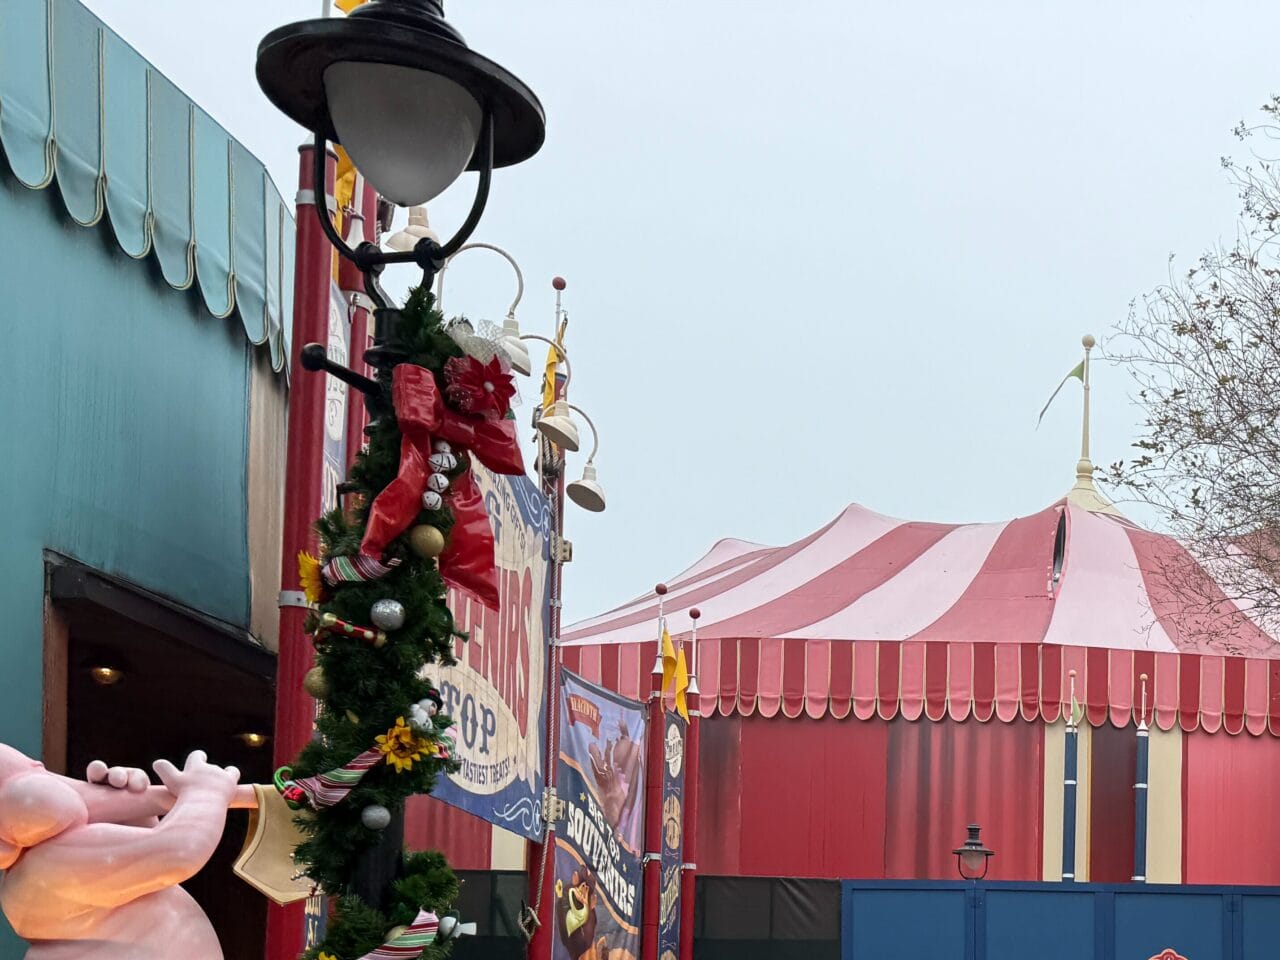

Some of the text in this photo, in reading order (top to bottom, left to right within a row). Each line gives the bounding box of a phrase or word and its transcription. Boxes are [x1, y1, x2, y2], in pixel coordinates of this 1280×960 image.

[440, 679, 496, 756] TOP
[462, 757, 488, 785] TASTIEST
[566, 801, 636, 917] SOUVENIRS
[587, 795, 621, 865] BIG TOP
